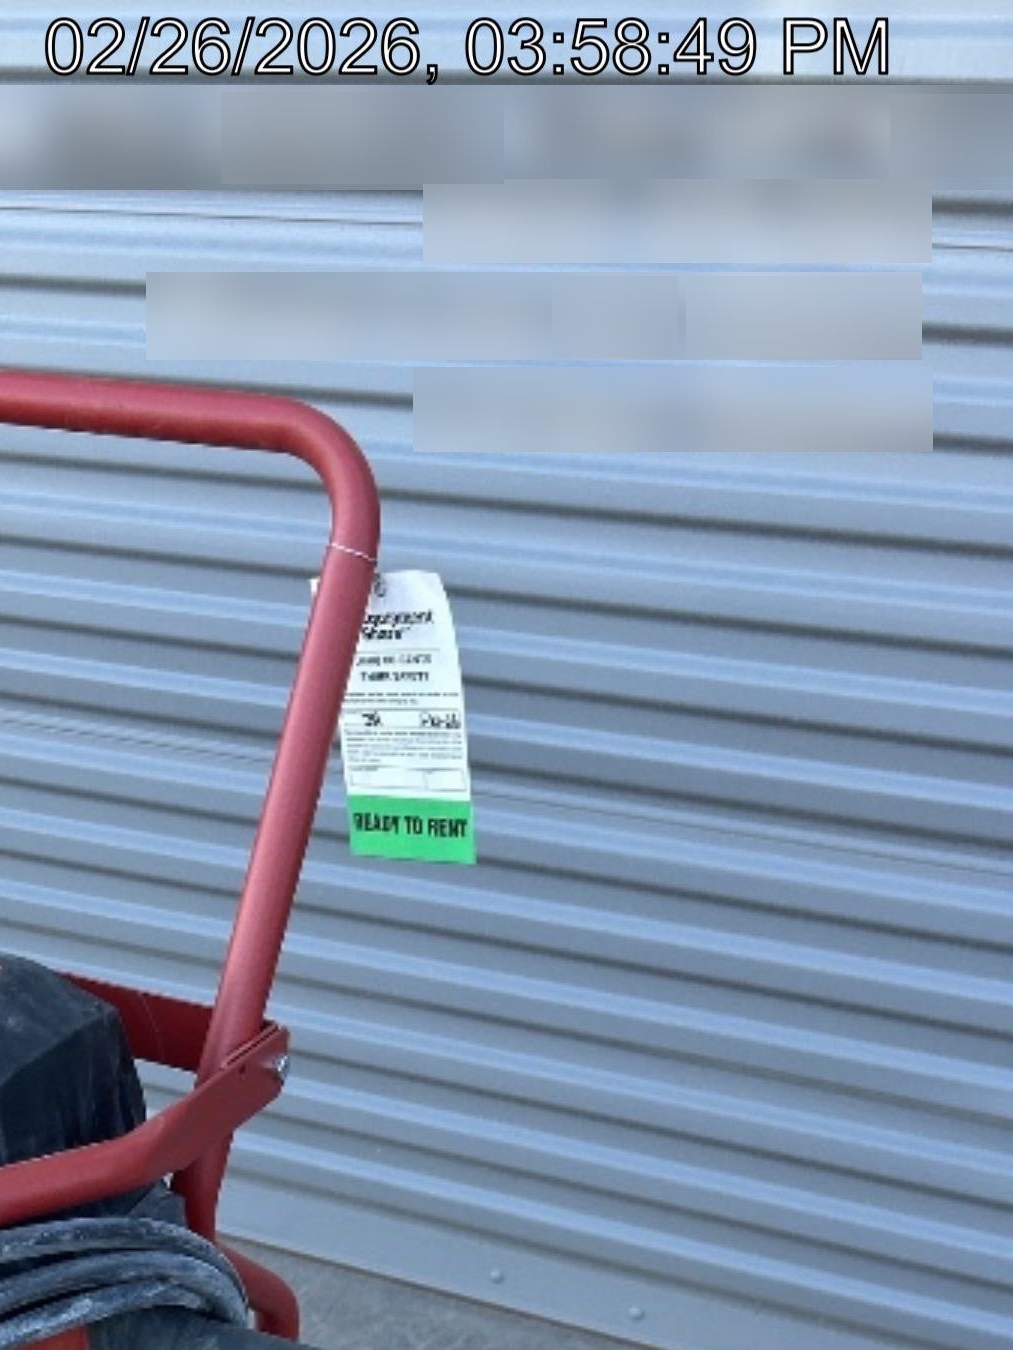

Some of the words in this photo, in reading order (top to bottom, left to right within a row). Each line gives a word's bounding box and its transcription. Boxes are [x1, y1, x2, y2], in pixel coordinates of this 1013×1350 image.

[352, 812, 401, 835] READY
[403, 815, 424, 835] TO
[428, 818, 468, 838] RENT
